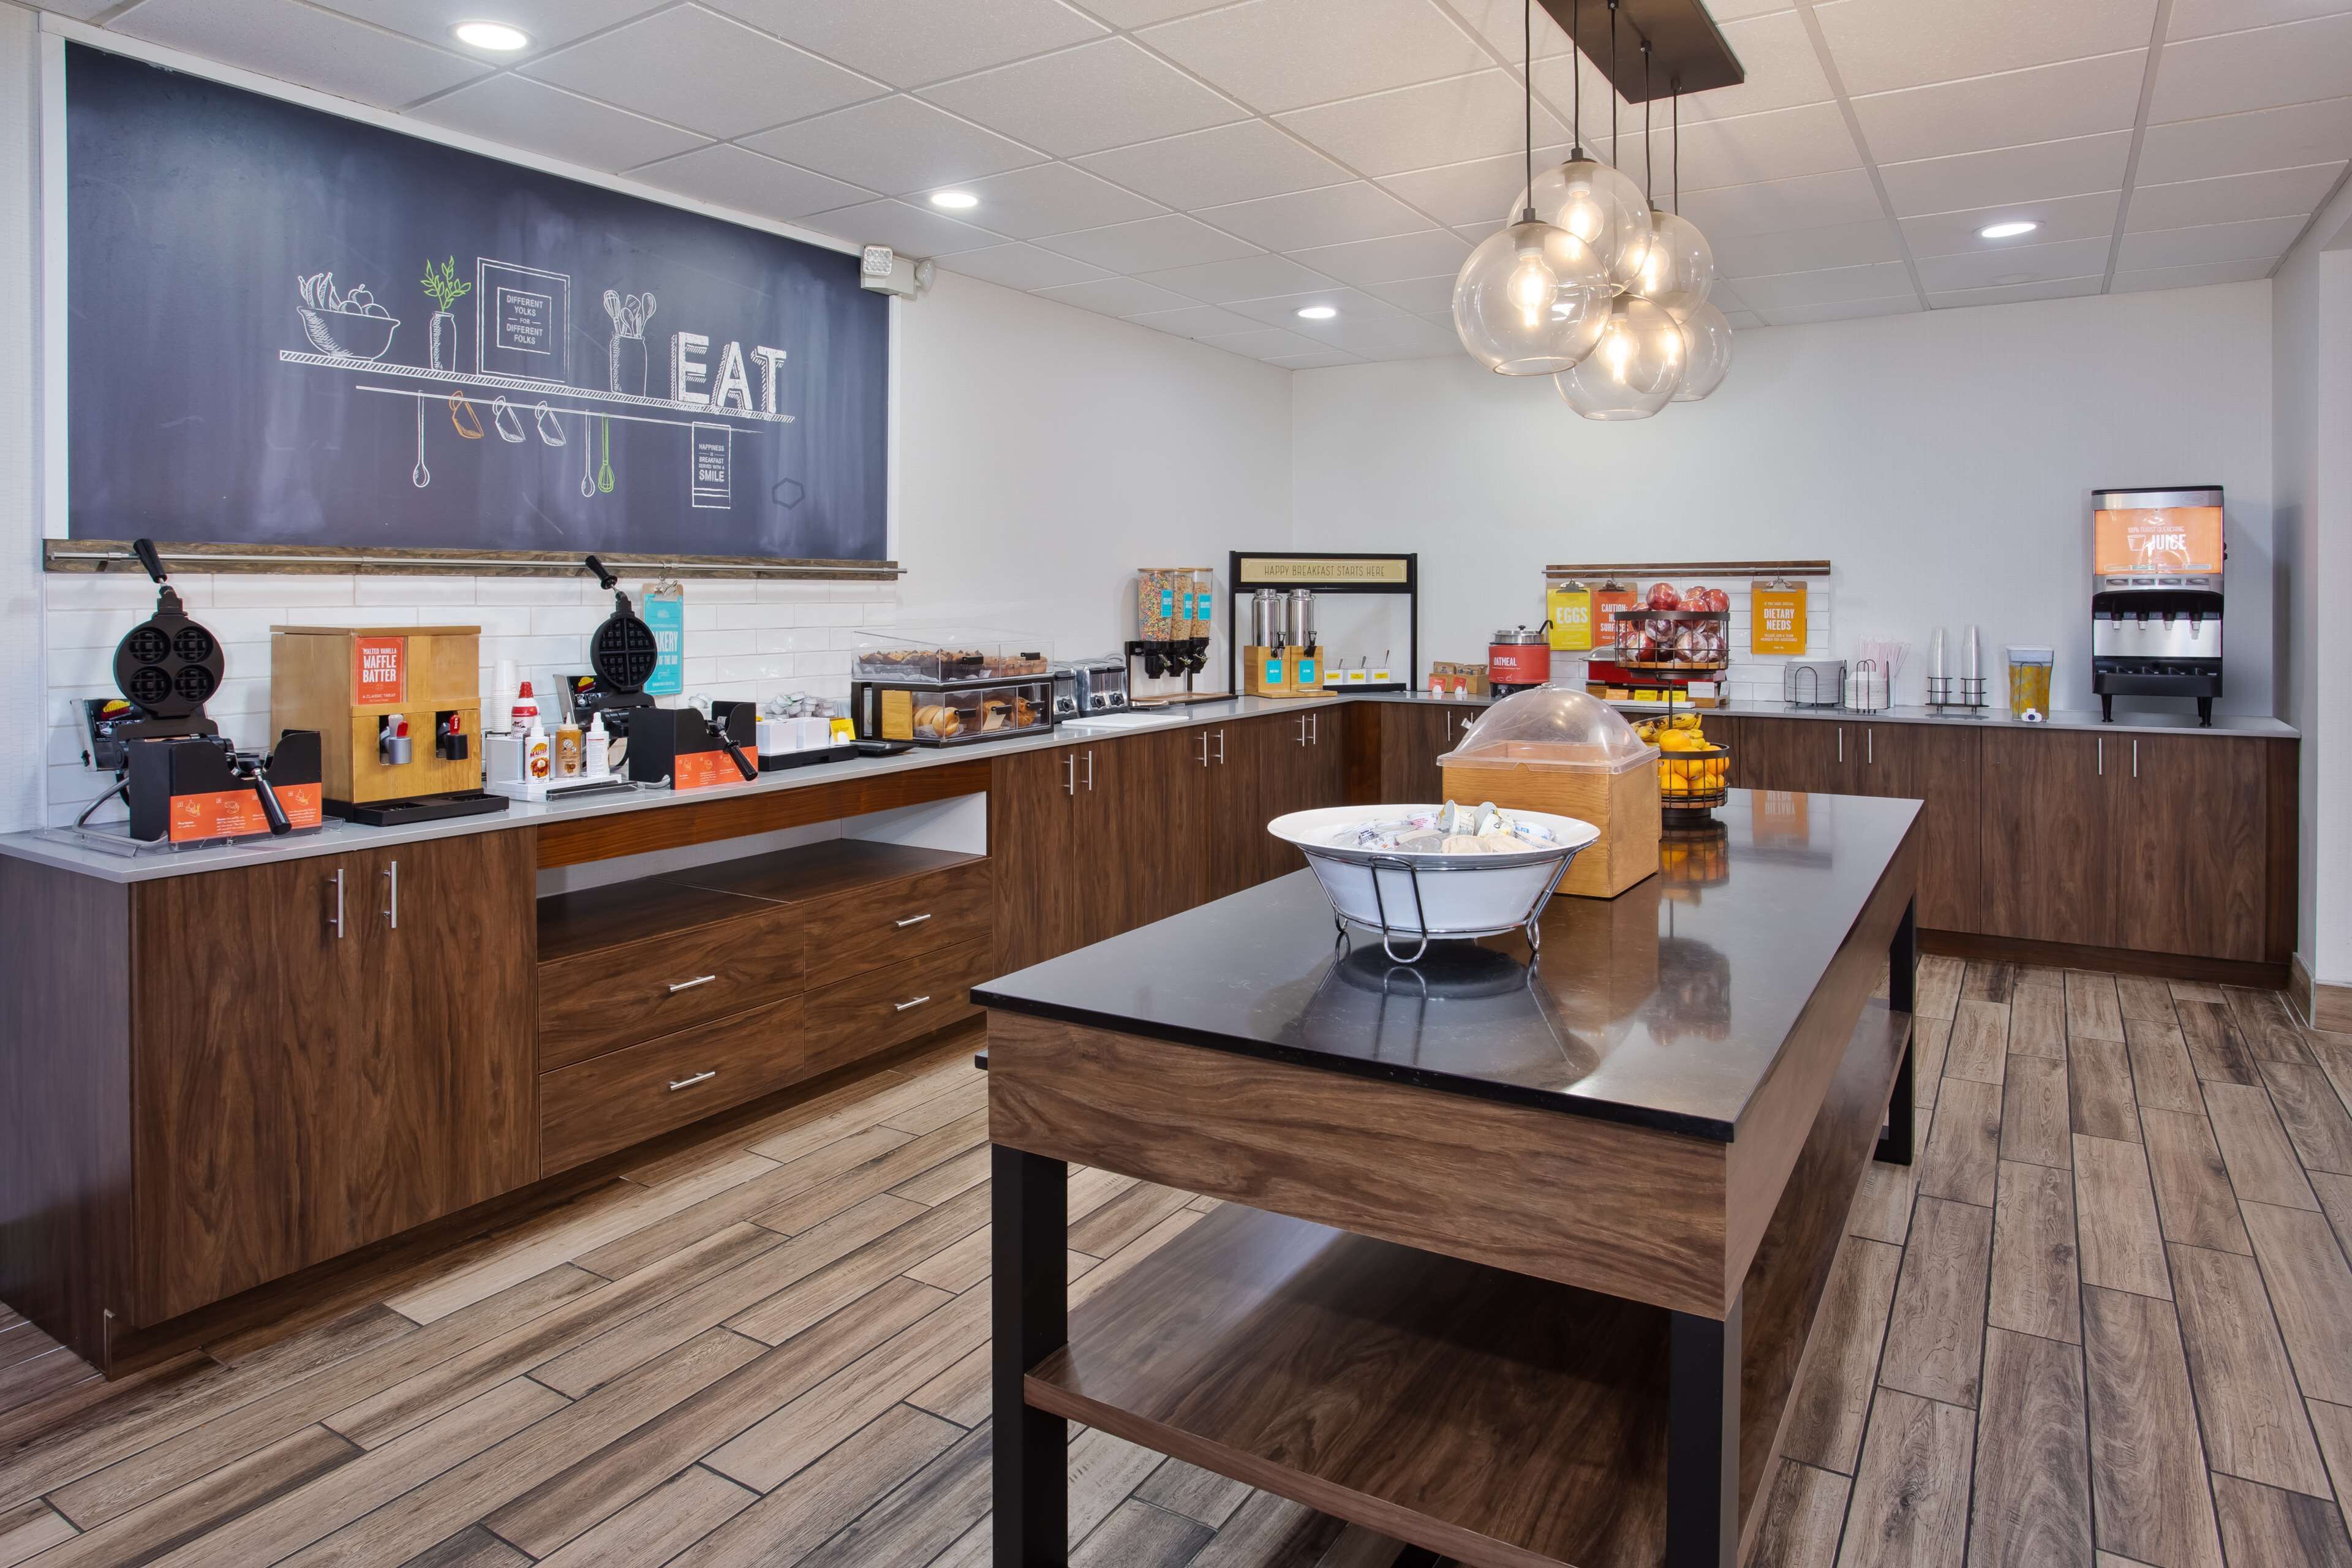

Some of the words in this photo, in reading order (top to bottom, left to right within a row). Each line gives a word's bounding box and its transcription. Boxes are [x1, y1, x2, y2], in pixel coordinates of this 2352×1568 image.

[507, 295, 543, 309] DIFFERENT
[514, 306, 536, 317] YOLKS
[506, 323, 543, 336] DIFFERENT
[514, 334, 535, 344] FOLKS
[672, 331, 787, 414] EAT
[699, 469, 725, 483] SMILE
[2150, 534, 2187, 550] JUICE
[1265, 565, 1289, 576] HAPPY
[1292, 565, 1335, 576] BREAKFAST
[1337, 566, 1363, 576] STARTS
[1366, 566, 1385, 576] HERE
[1601, 603, 1627, 612] CAUTION:
[1764, 608, 1795, 619] DIETARY
[1556, 607, 1588, 624] EGGS
[1766, 620, 1792, 630] NEEDS
[363, 655, 397, 669] WAFFLE
[1494, 657, 1517, 666] OATMEAL
[363, 669, 396, 683] BATTER
